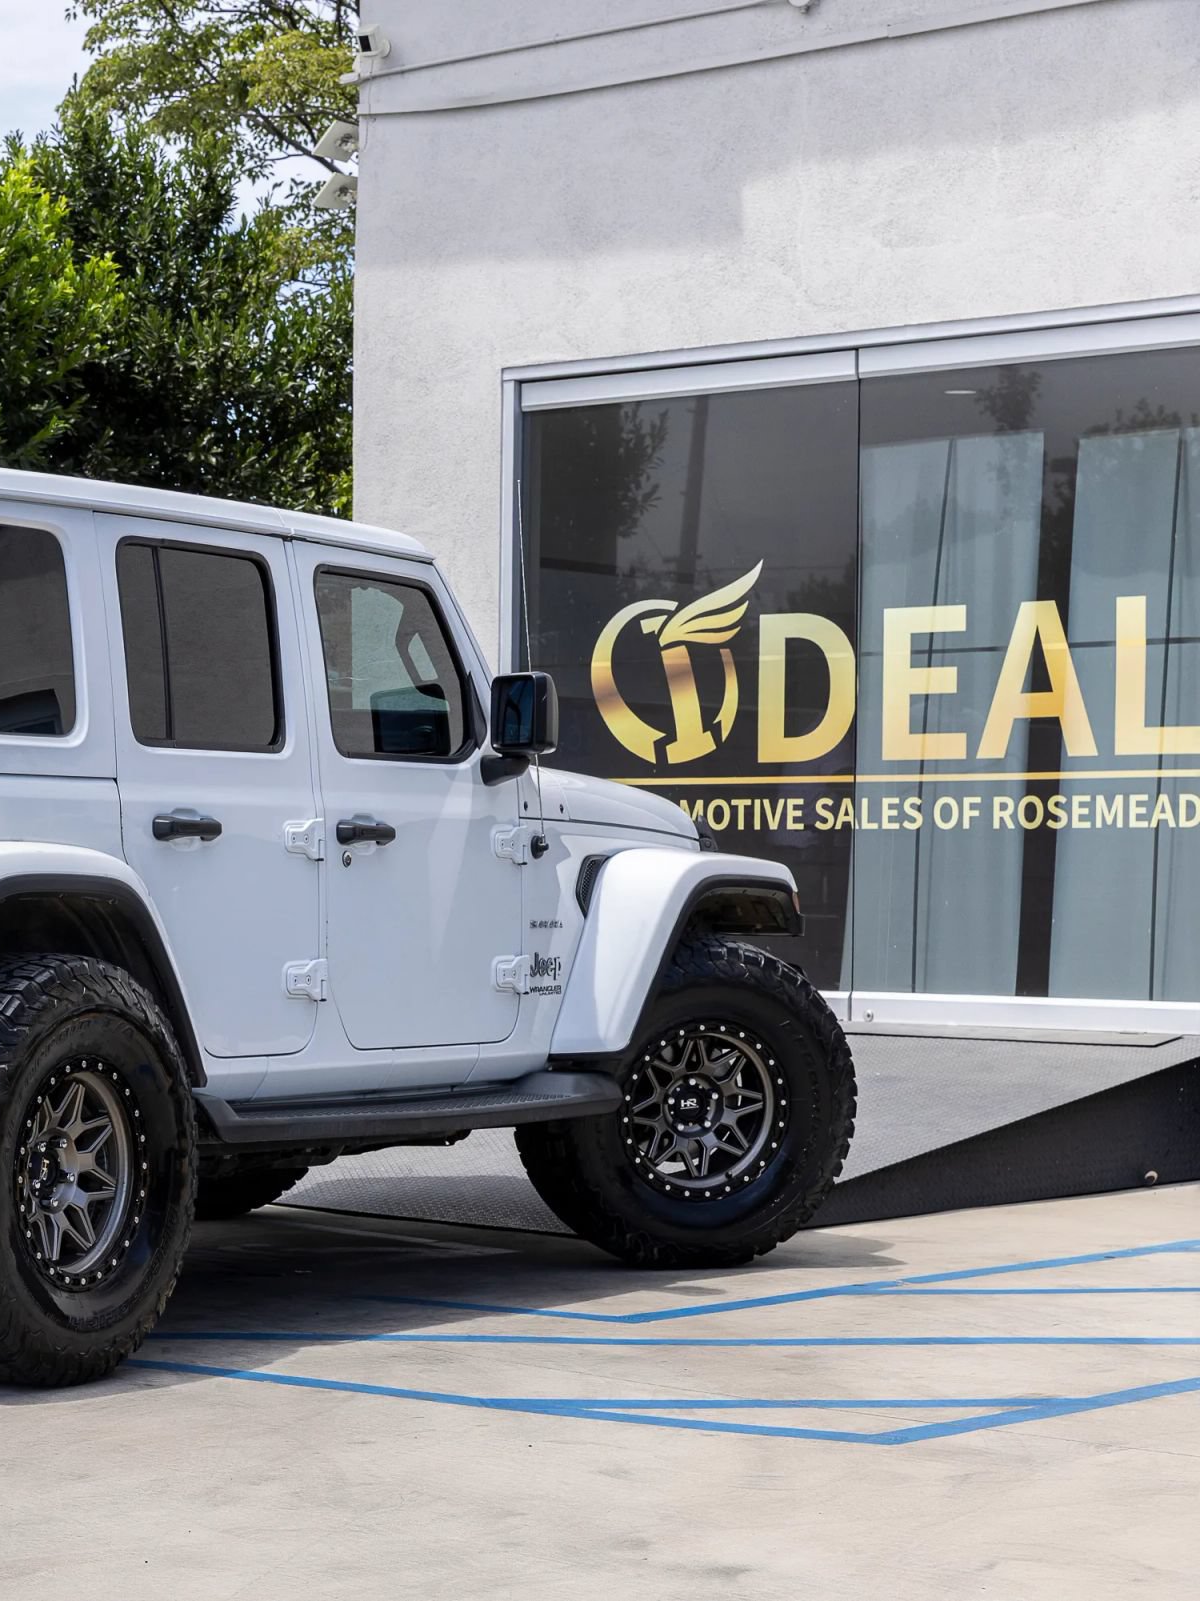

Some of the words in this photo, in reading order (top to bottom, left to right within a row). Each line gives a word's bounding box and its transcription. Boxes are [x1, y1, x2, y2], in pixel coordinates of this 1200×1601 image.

[814, 797, 924, 831] SALES
[933, 796, 981, 830] OF
[992, 794, 1200, 830] ROSEMEAD
[529, 952, 562, 981] Jeep
